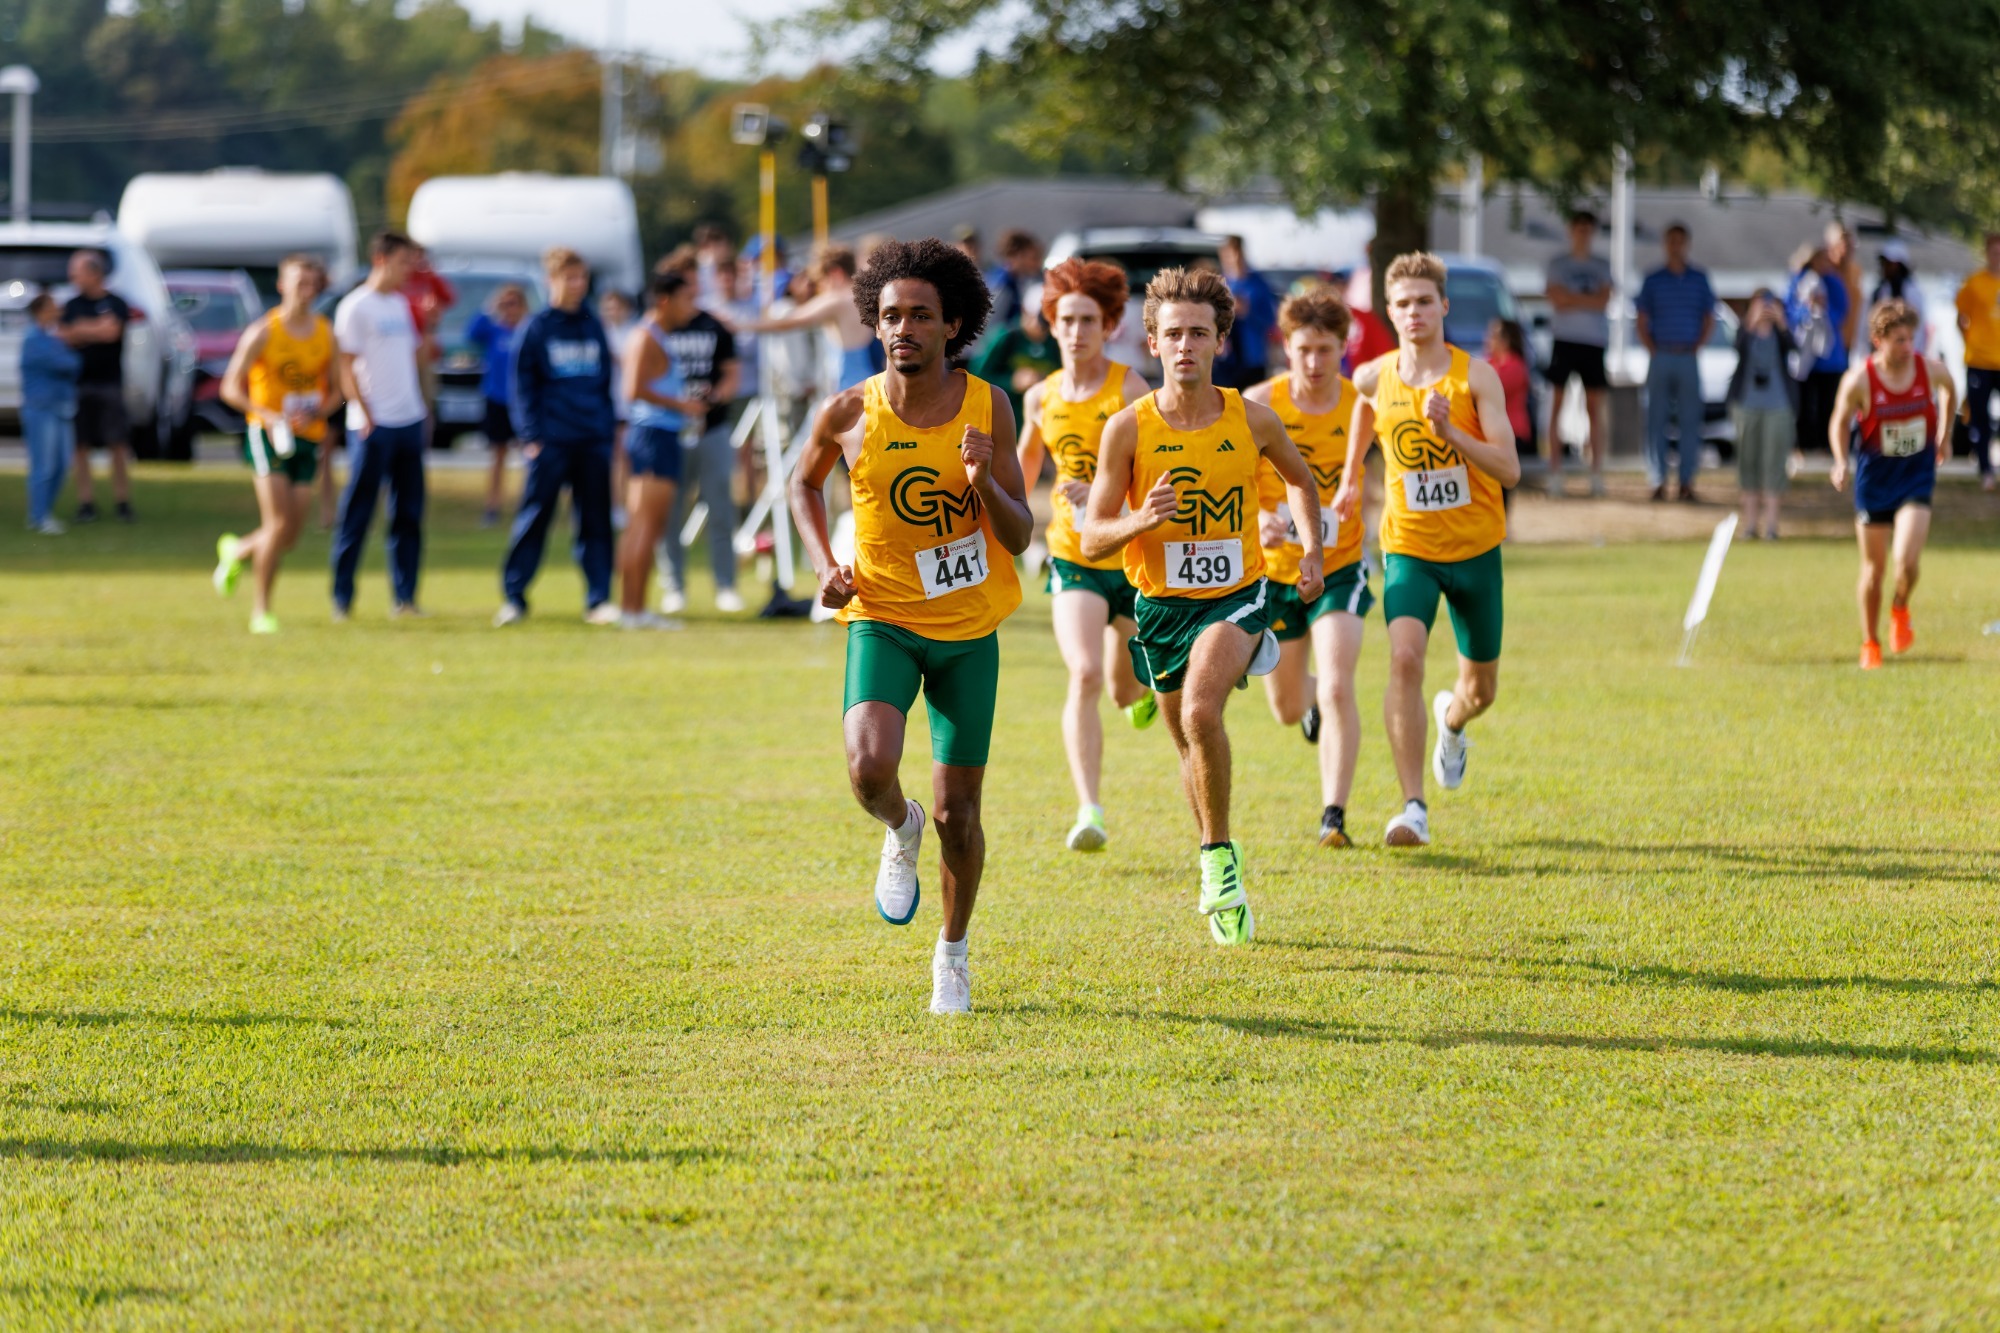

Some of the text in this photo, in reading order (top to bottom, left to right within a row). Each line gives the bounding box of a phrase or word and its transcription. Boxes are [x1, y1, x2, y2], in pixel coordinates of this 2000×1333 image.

[884, 441, 918, 452] A10
[1153, 444, 1184, 453] A10
[1415, 479, 1460, 507] 449
[935, 548, 984, 588] 441
[1178, 554, 1231, 585] 439
